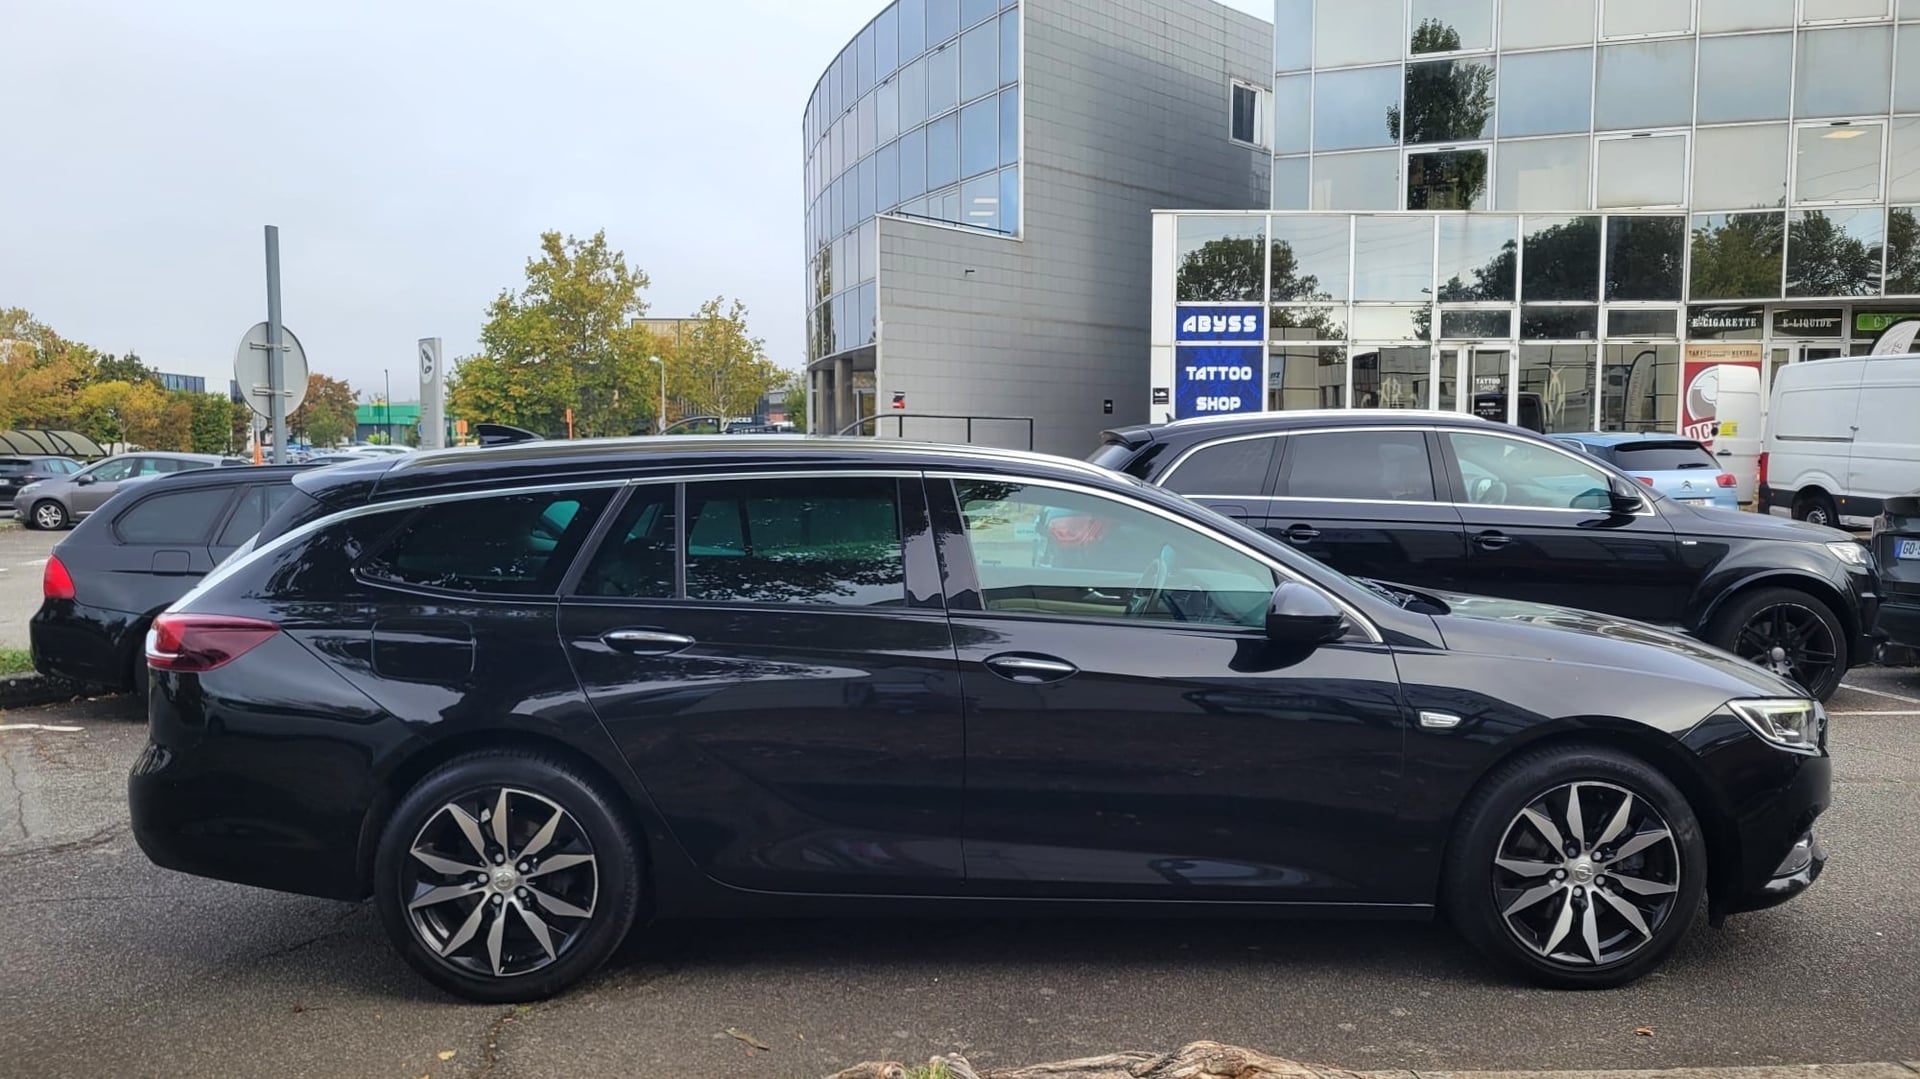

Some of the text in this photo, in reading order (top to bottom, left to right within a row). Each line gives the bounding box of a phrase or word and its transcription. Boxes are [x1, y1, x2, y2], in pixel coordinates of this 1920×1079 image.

[1182, 315, 1257, 332] ABYSS
[1692, 317, 1757, 328] E-CIGARETTE
[1783, 318, 1832, 328] E-LIQUIDE
[1185, 366, 1252, 380] TATTOO
[1196, 396, 1241, 411] SHOP
